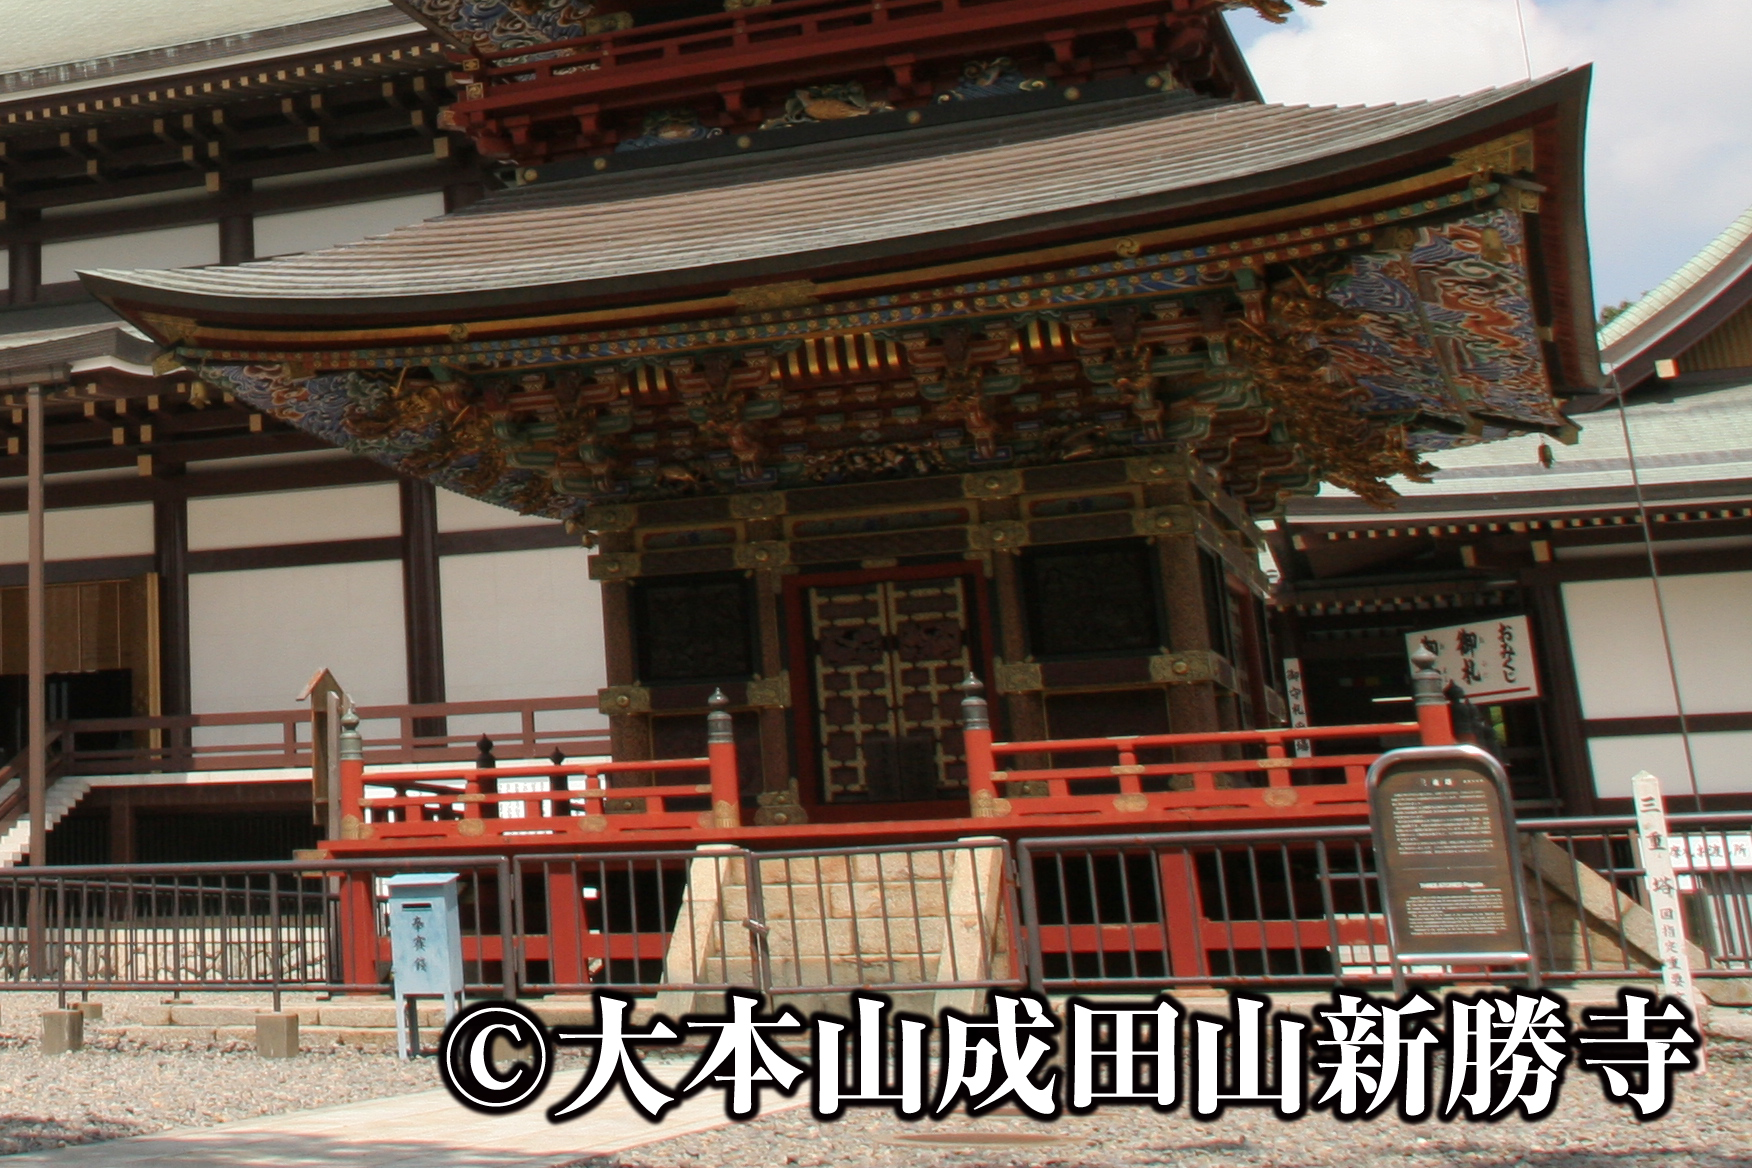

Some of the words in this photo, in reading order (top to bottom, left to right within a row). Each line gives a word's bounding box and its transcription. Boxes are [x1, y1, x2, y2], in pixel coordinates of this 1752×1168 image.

[1498, 622, 1516, 683] おみくじ
[1639, 795, 1677, 898] 三重塔
